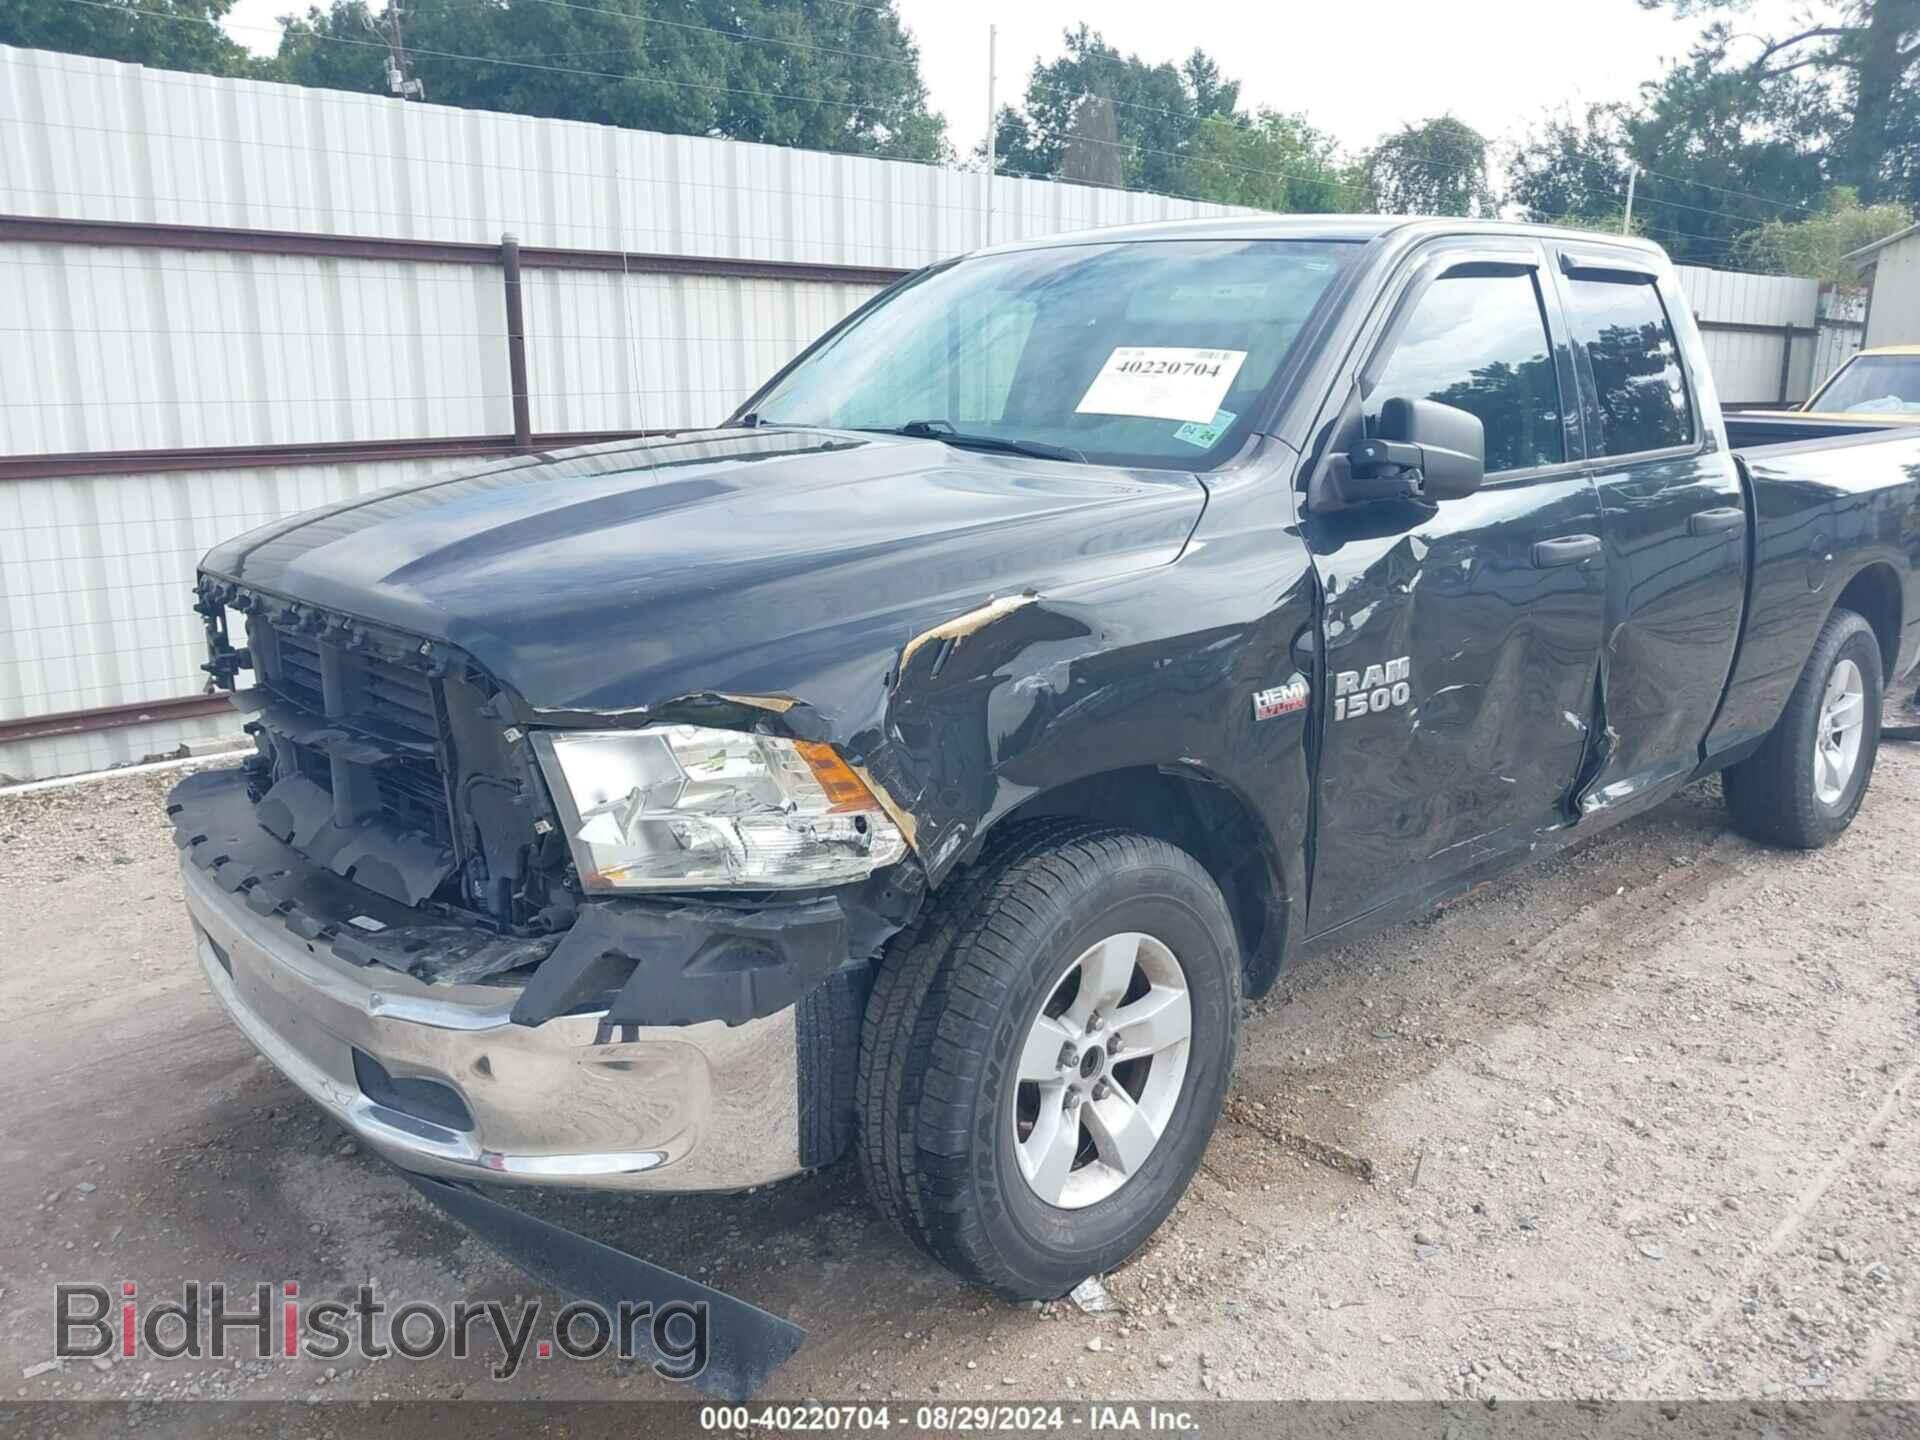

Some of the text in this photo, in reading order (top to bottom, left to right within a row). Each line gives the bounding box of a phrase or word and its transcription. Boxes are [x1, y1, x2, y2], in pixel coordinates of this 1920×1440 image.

[1117, 361, 1221, 377] 40220704
[1336, 655, 1410, 696] RAM
[1252, 682, 1305, 706] HEMI
[1334, 682, 1410, 721] 1500
